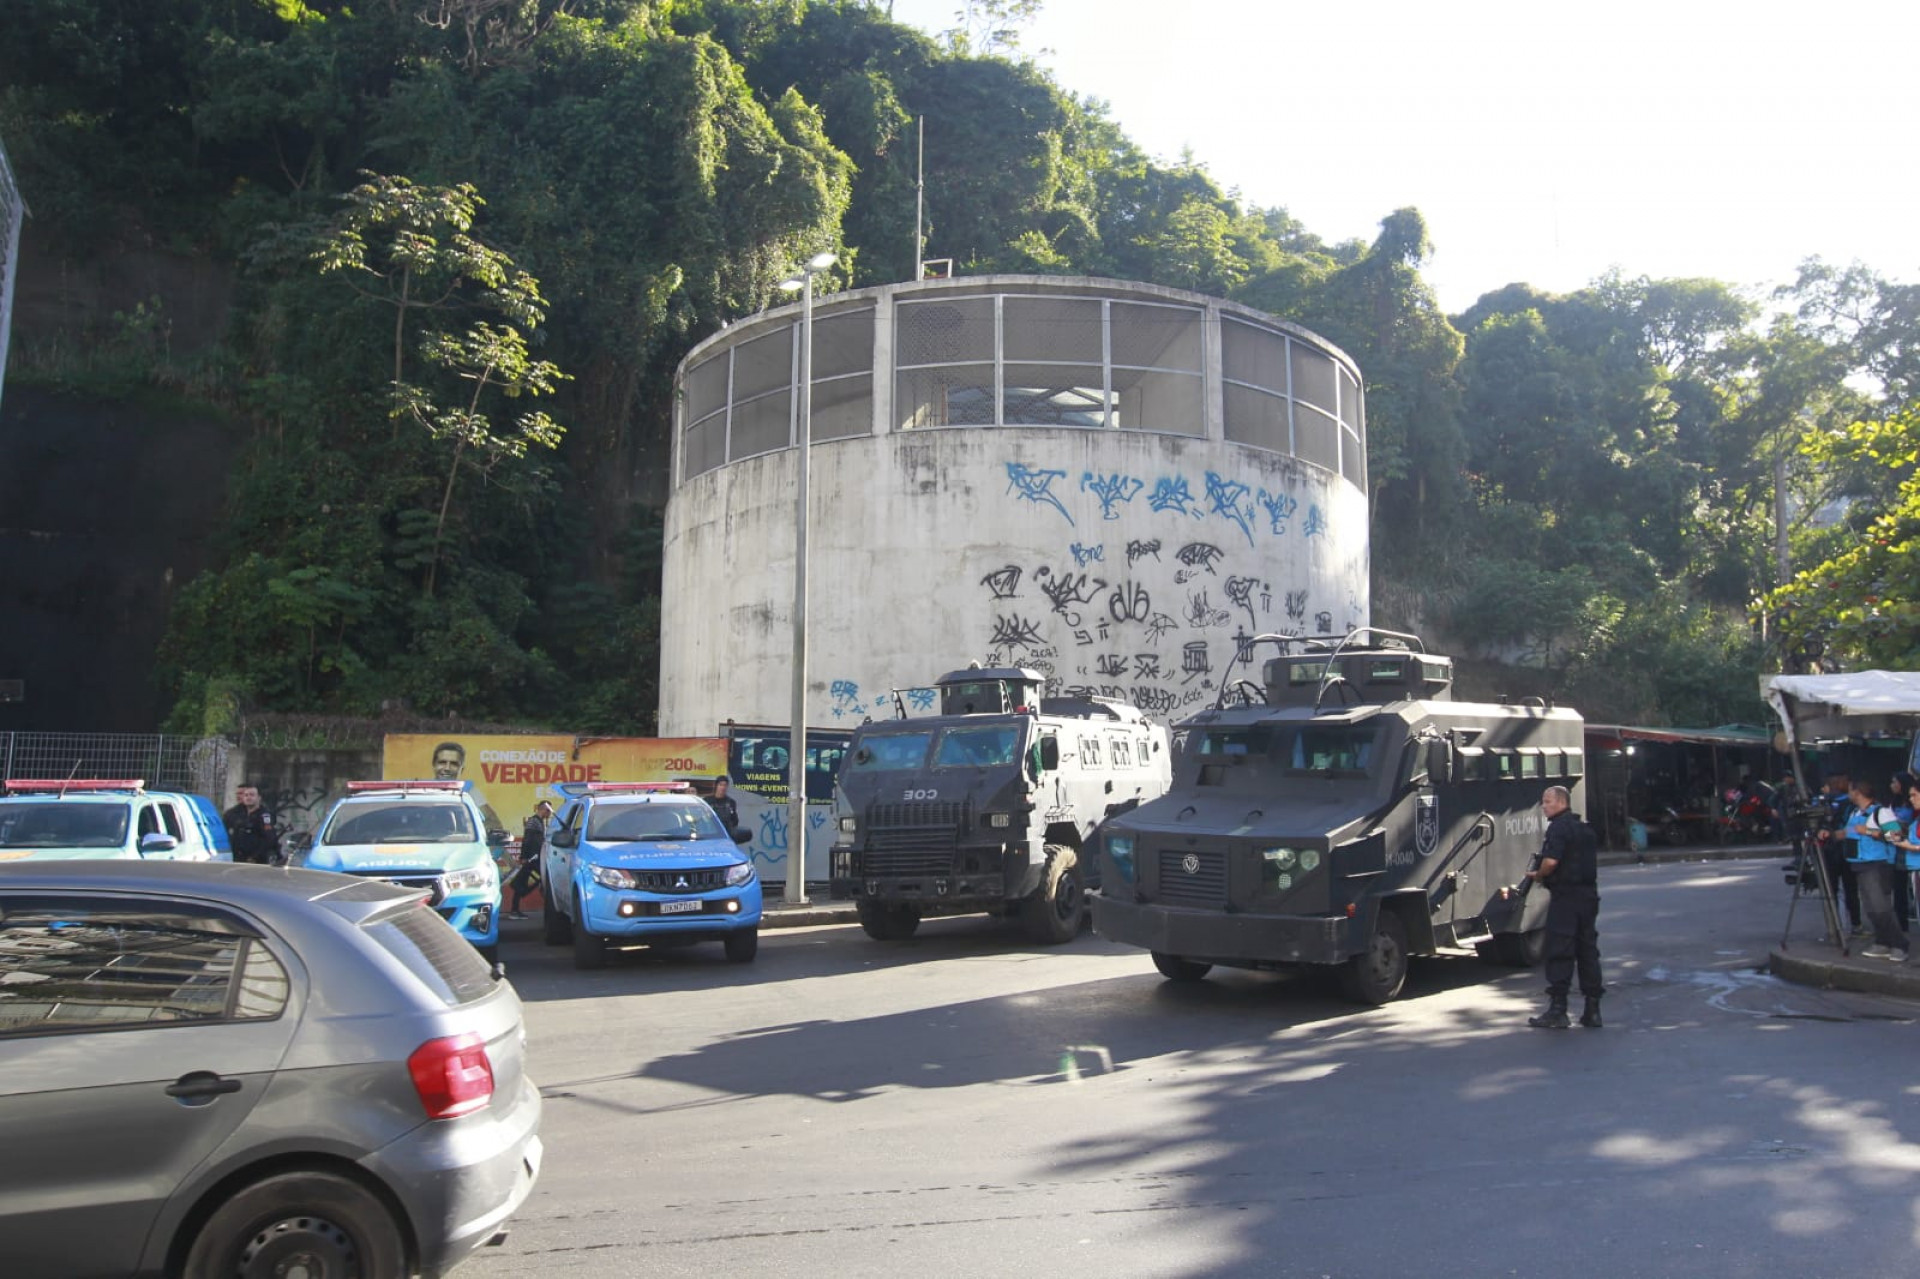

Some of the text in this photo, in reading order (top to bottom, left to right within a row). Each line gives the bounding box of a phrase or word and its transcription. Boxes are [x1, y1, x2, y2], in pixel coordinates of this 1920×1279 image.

[480, 749, 567, 763] CONEXÃO DE
[480, 763, 602, 783] VERDADE
